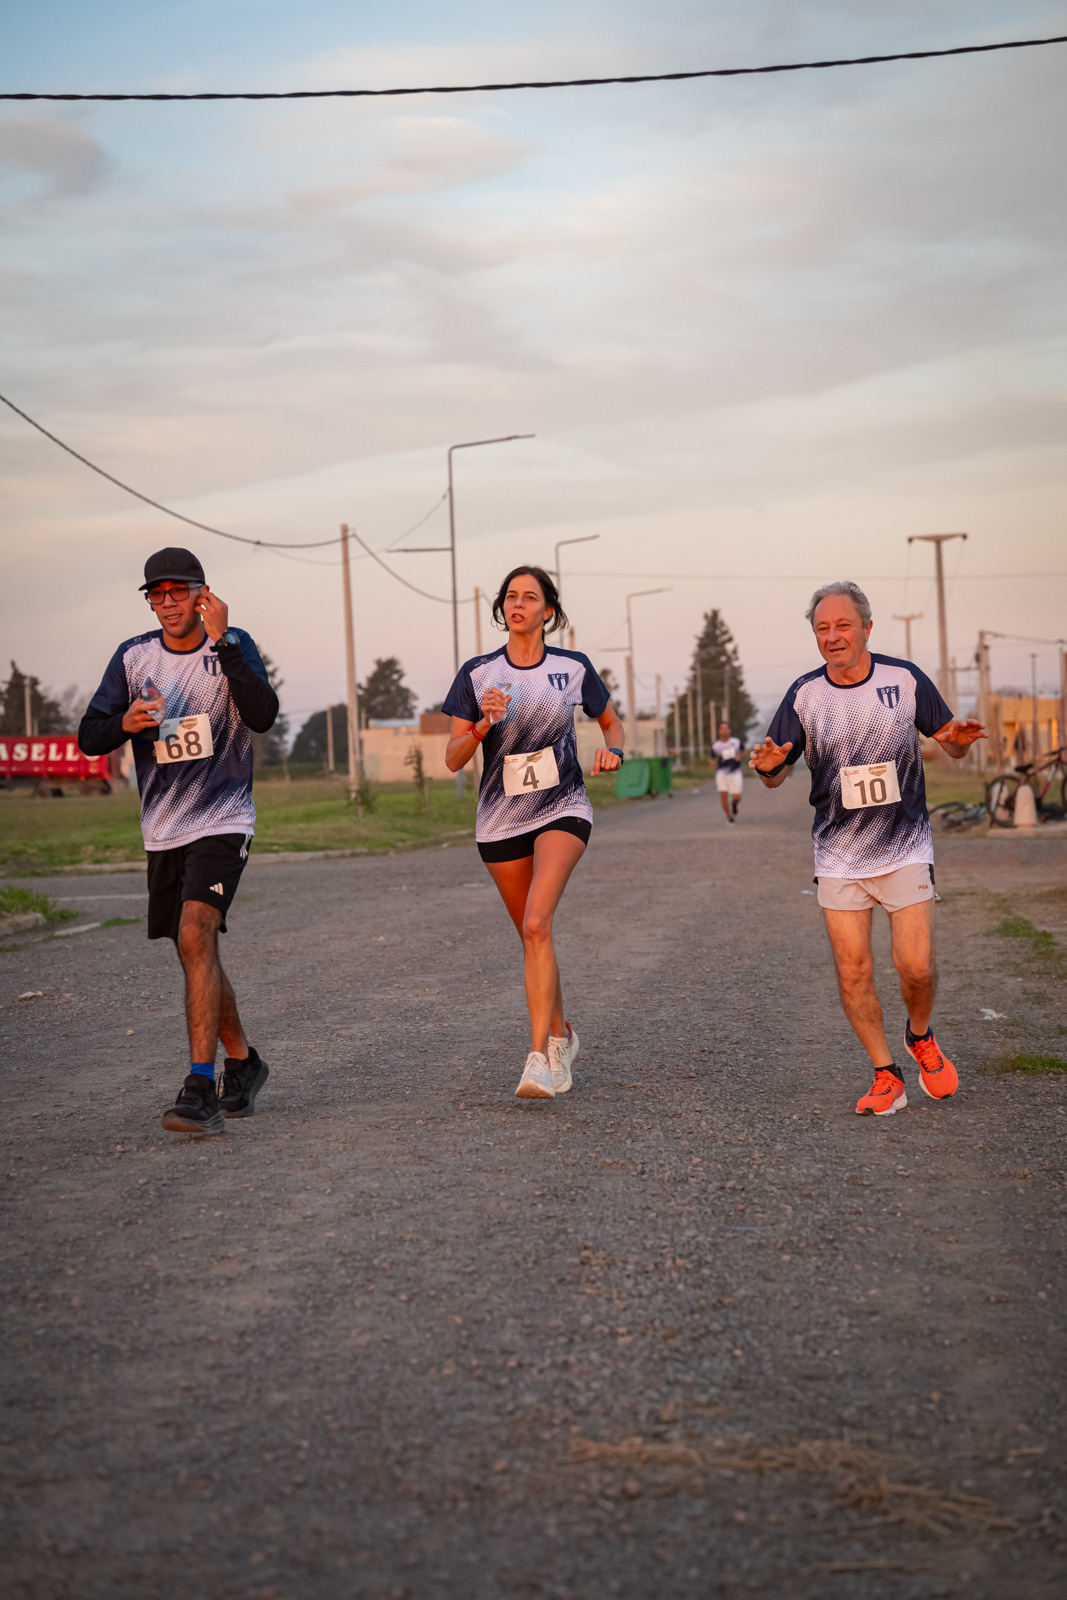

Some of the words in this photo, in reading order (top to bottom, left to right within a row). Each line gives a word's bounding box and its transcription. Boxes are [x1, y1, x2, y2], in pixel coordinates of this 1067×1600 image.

[880, 687, 896, 695] SFC
[165, 731, 203, 760] 68
[523, 765, 540, 789] 4
[854, 778, 887, 805] 10
